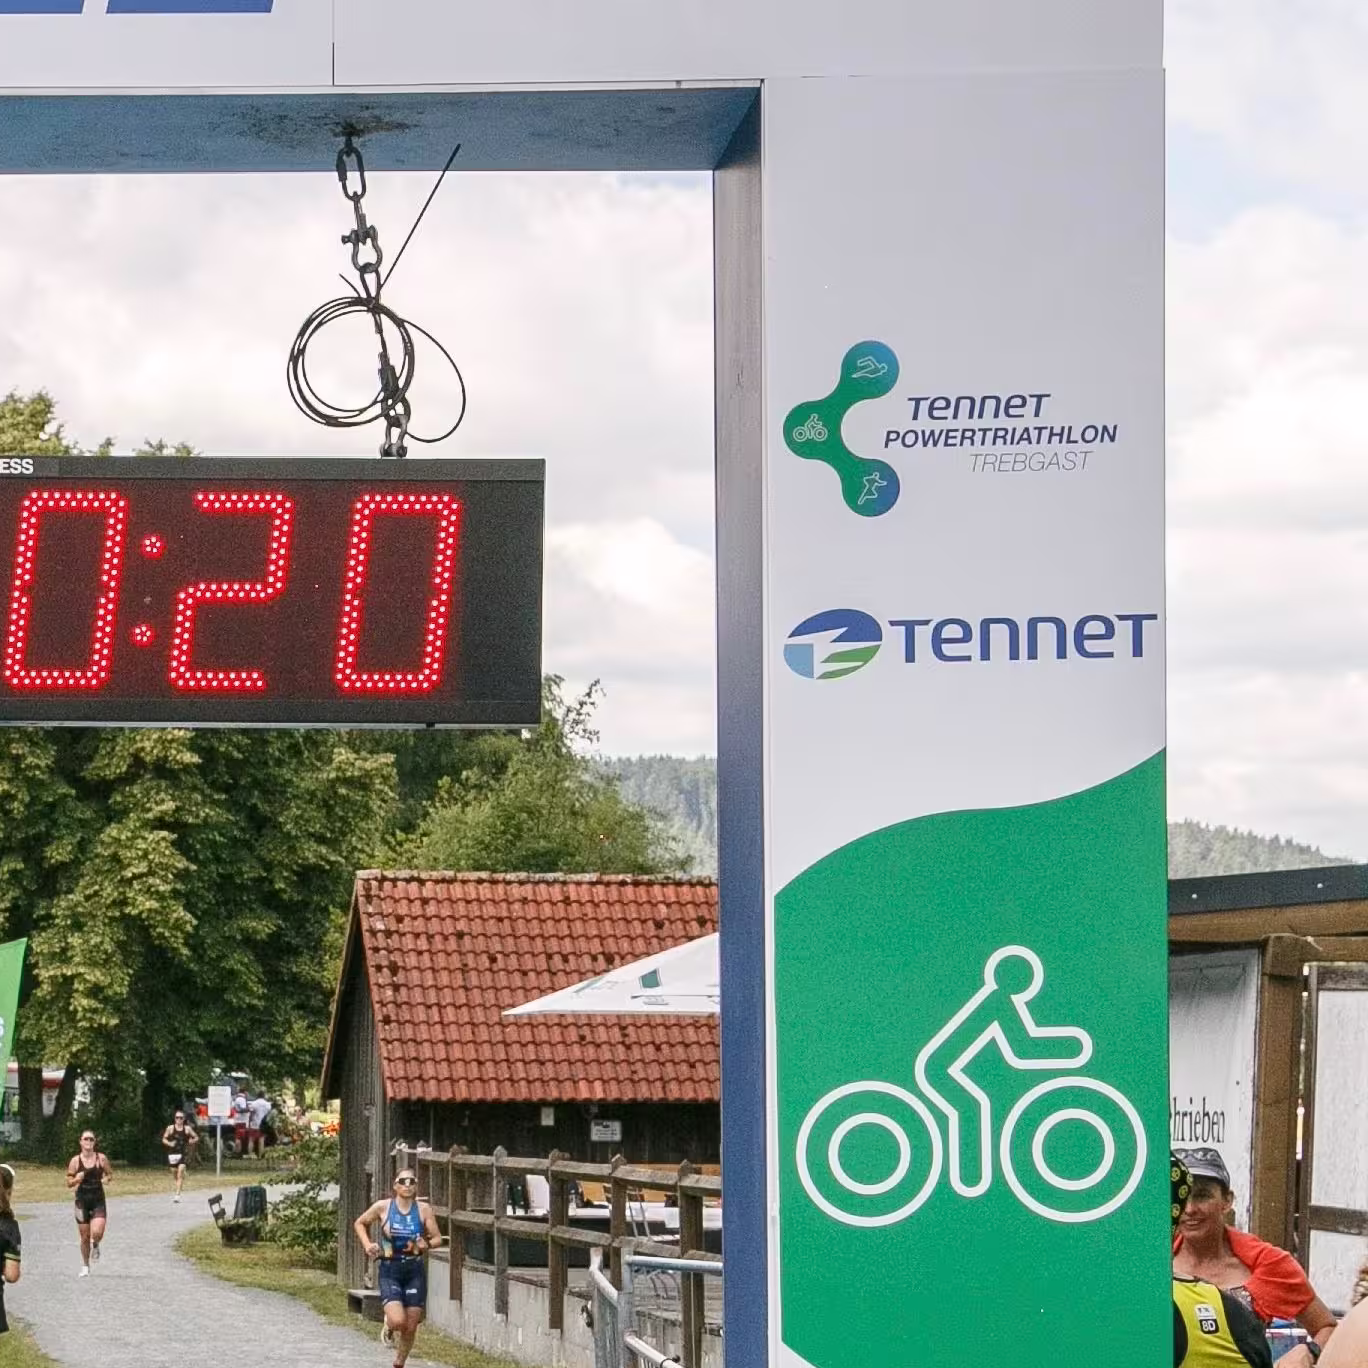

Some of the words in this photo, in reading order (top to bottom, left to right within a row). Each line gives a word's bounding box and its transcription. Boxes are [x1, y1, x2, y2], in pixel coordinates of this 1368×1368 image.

[884, 424, 1119, 449] POWERTRIATHLON
[970, 451, 1094, 473] TREBGAST
[1169, 1096, 1225, 1143] hrieben
